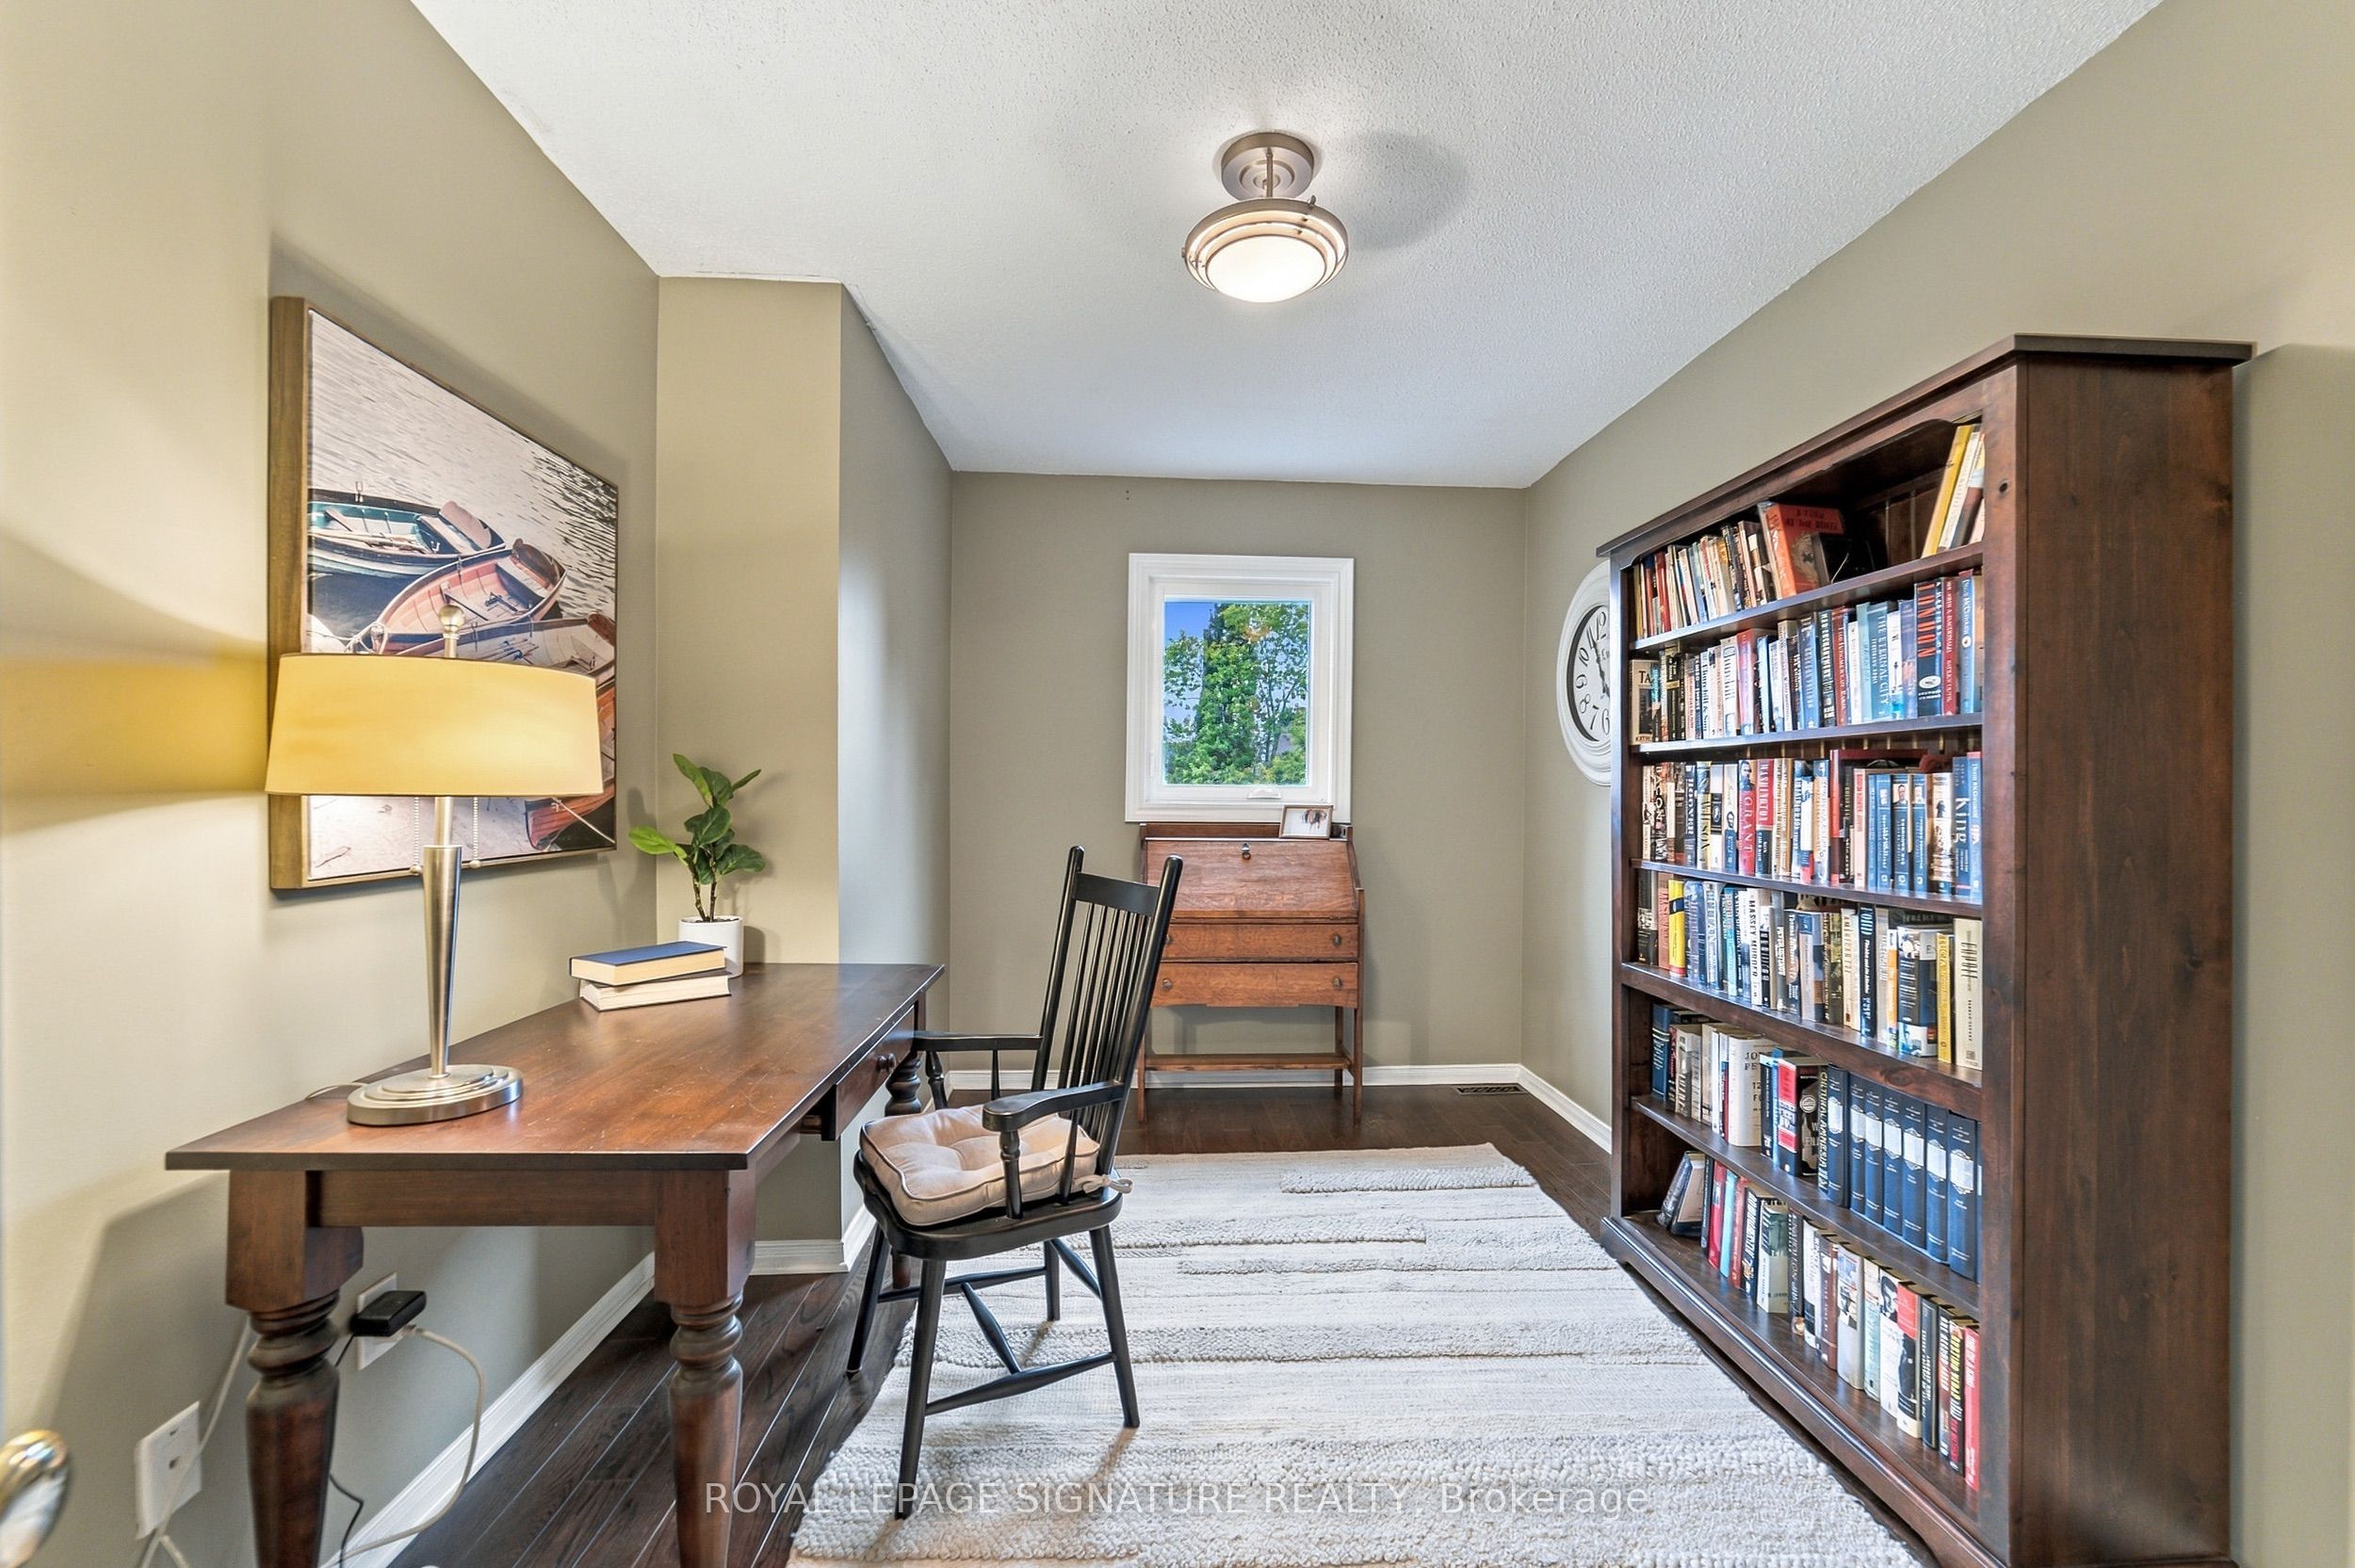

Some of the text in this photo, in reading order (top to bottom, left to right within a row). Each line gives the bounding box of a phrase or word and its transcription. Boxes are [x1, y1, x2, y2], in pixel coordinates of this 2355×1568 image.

[1917, 583, 1936, 657] LONDON
[1575, 674, 1588, 689] 9
[1638, 670, 1652, 684] TA
[1877, 615, 1890, 704] THE ETERNAL CITY
[1579, 693, 1591, 714] 8
[1590, 704, 1600, 730] 7
[1601, 708, 1611, 736] 6
[1655, 766, 1664, 821] BACON
[1759, 764, 1769, 821] WASHINGTON
[1700, 800, 1711, 849] WILSON
[1744, 797, 1753, 852] GRANT
[1953, 797, 1970, 844] King
[1748, 899, 1757, 935] MASSEY
[1819, 1071, 1827, 1168] CULTURAL AMNESIA
[1950, 1372, 1961, 1401] VEGAS
